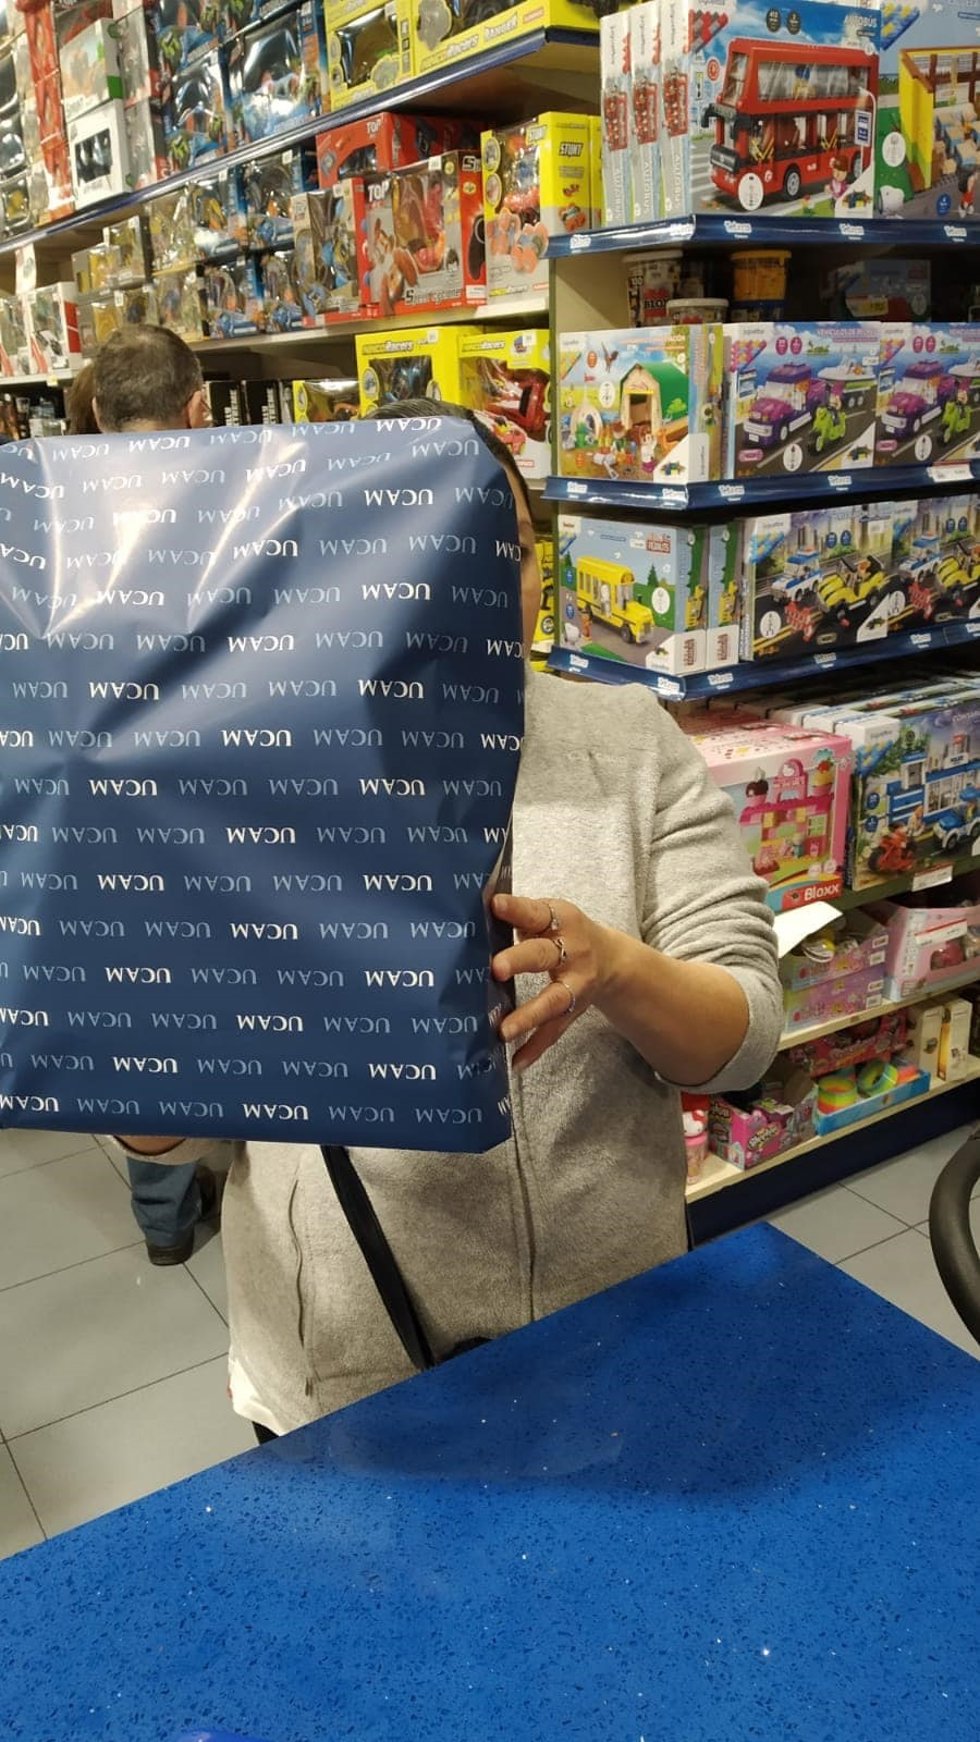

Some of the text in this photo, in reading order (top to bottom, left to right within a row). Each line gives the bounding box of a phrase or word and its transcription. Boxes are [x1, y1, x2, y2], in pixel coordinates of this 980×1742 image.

[368, 179, 389, 202] TOP
[1, 418, 442, 461] UC UCAM UCAM UCAM UCAM UCAM
[0, 440, 479, 499] UCAM UCAM UCAM UCAM UCAM UCAM
[34, 517, 94, 533] UCAM
[198, 506, 260, 523] UCAM
[279, 491, 342, 510] UCAM
[364, 489, 433, 506] UCAM
[455, 487, 513, 509] UCAM
[0, 542, 46, 570] UCA
[148, 550, 214, 566] UCAM
[233, 538, 298, 560] UCAM
[320, 538, 387, 558] UCAM
[409, 535, 476, 554] UCAM
[495, 540, 522, 562] CAM
[12, 583, 508, 609] UCAM UCAM UCAM UCAM UCAM UCAM
[0, 631, 523, 658] UC UCAM UCAM UCAM UCAM UCAM CAM
[13, 682, 68, 698] UCAM
[89, 682, 159, 700] UCAM
[182, 682, 247, 699] UCAM
[269, 680, 336, 697] UCAM
[358, 679, 424, 699] UCAM
[442, 683, 500, 704] UCAM
[0, 729, 524, 751] UCA UCAM UCAM UCAM UCAM UCAM CAM
[14, 778, 502, 796] UCAM UCAM UCAM UCAM UCAM UCAM
[0, 825, 38, 843] UCA
[51, 827, 118, 844] UCAM
[136, 827, 206, 844] UCAM
[225, 827, 295, 844] UCAM
[317, 827, 386, 844] UCAM
[407, 827, 469, 844] UCAM
[21, 872, 79, 891] UCAM
[97, 874, 165, 892] UCAM
[184, 875, 251, 893] UCAM
[273, 874, 343, 892] UCAM
[362, 874, 433, 892] UCAM
[453, 872, 491, 890] AM
[804, 883, 839, 901] Bloxx
[59, 920, 126, 937] UCAM
[145, 921, 211, 939] UCAM
[229, 923, 299, 941] UCAM
[319, 922, 389, 940] UCAM
[410, 921, 476, 939] UCAM
[23, 965, 87, 983] UCAM
[105, 967, 171, 984] UCAM
[191, 968, 257, 985] UCAM
[277, 969, 344, 987] UCAM
[364, 970, 435, 988] UCAM
[455, 967, 491, 984] AM
[67, 1011, 132, 1028] UCAM
[151, 1012, 217, 1030] UCAM
[236, 1014, 304, 1032] UCAM
[324, 1017, 391, 1034] UCAM
[412, 1016, 478, 1033] UCAM
[31, 1055, 94, 1071] UCAM
[113, 1056, 179, 1074] UCAM
[197, 1059, 262, 1075] UCAM
[282, 1061, 349, 1078] UCAM
[368, 1063, 437, 1081] UCAM
[77, 1098, 140, 1115] UCAM
[160, 1101, 224, 1118] UCAM
[243, 1103, 309, 1120] UCAM
[328, 1106, 395, 1123] UCAM
[415, 1107, 482, 1124] UCAM
